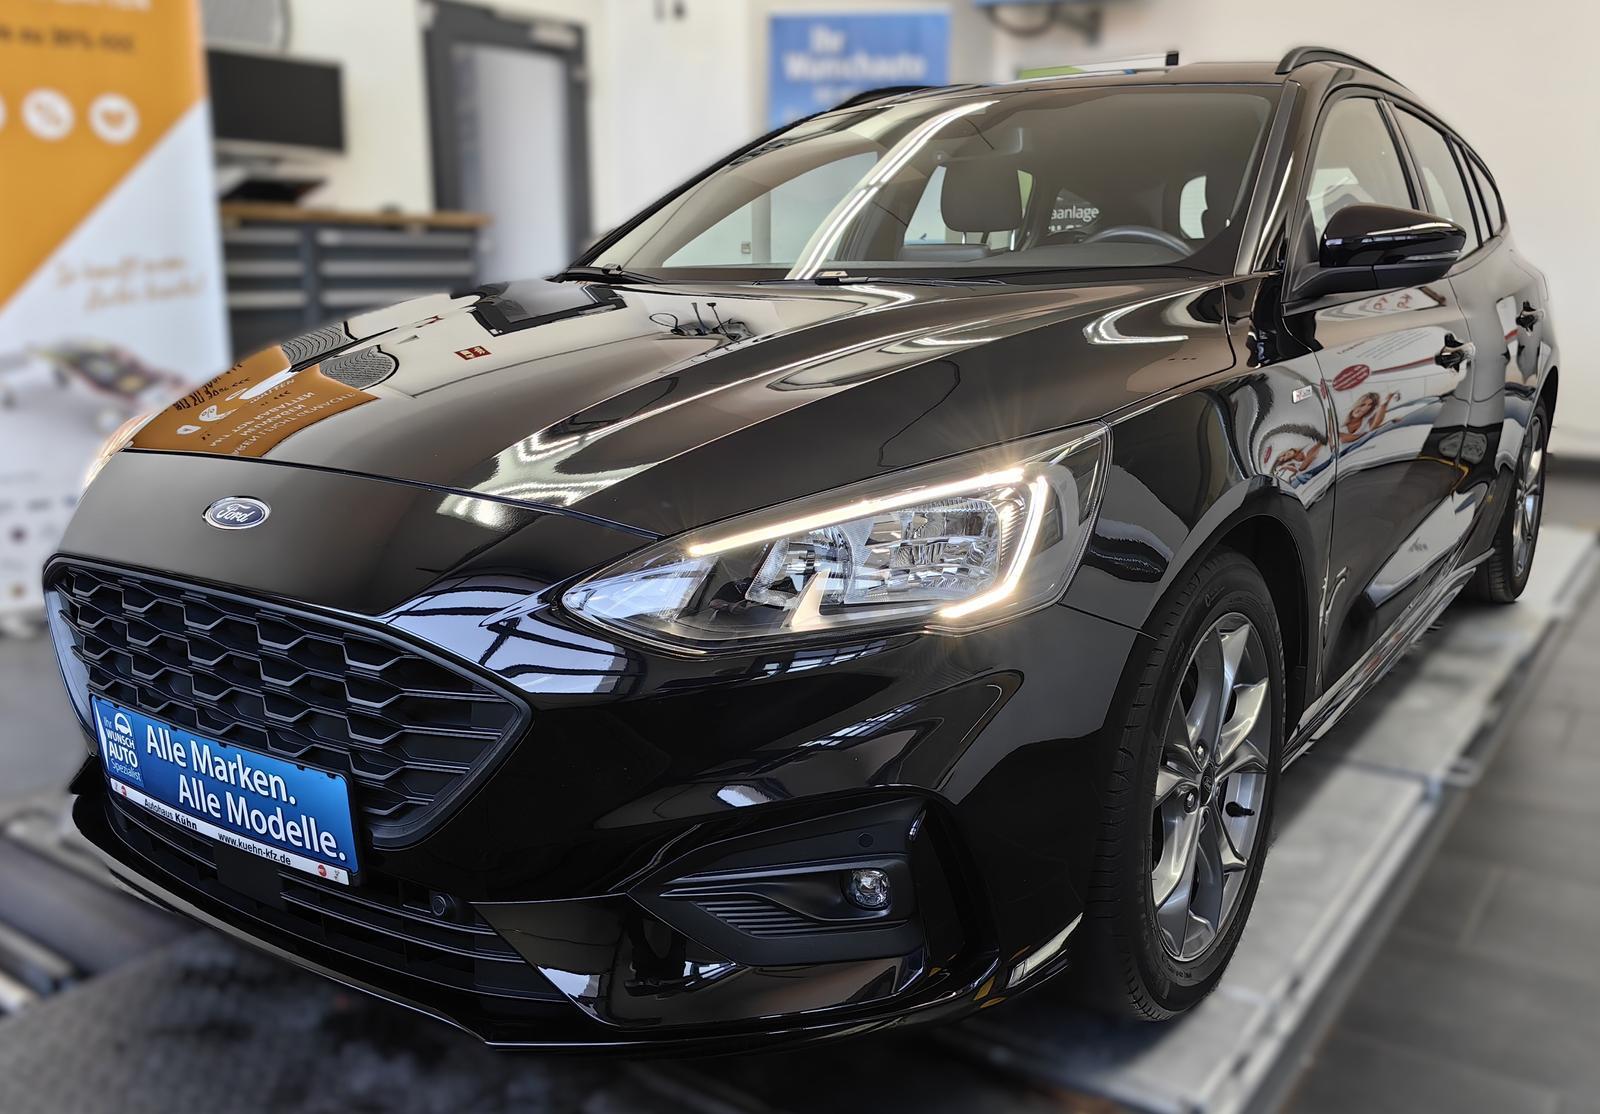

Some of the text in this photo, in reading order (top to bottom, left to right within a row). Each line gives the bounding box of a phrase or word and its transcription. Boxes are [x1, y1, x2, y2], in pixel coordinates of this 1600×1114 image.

[216, 503, 256, 523] Ford
[105, 728, 136, 750] WUNSCH
[109, 741, 138, 768] AUTO
[147, 724, 297, 806] Alle Marken.
[111, 758, 143, 782] Spezialist
[144, 798, 198, 831] Autohaus Kühn
[179, 774, 347, 862] Alle Modelle.
[217, 832, 291, 866] www.kuehn-kfz.de
